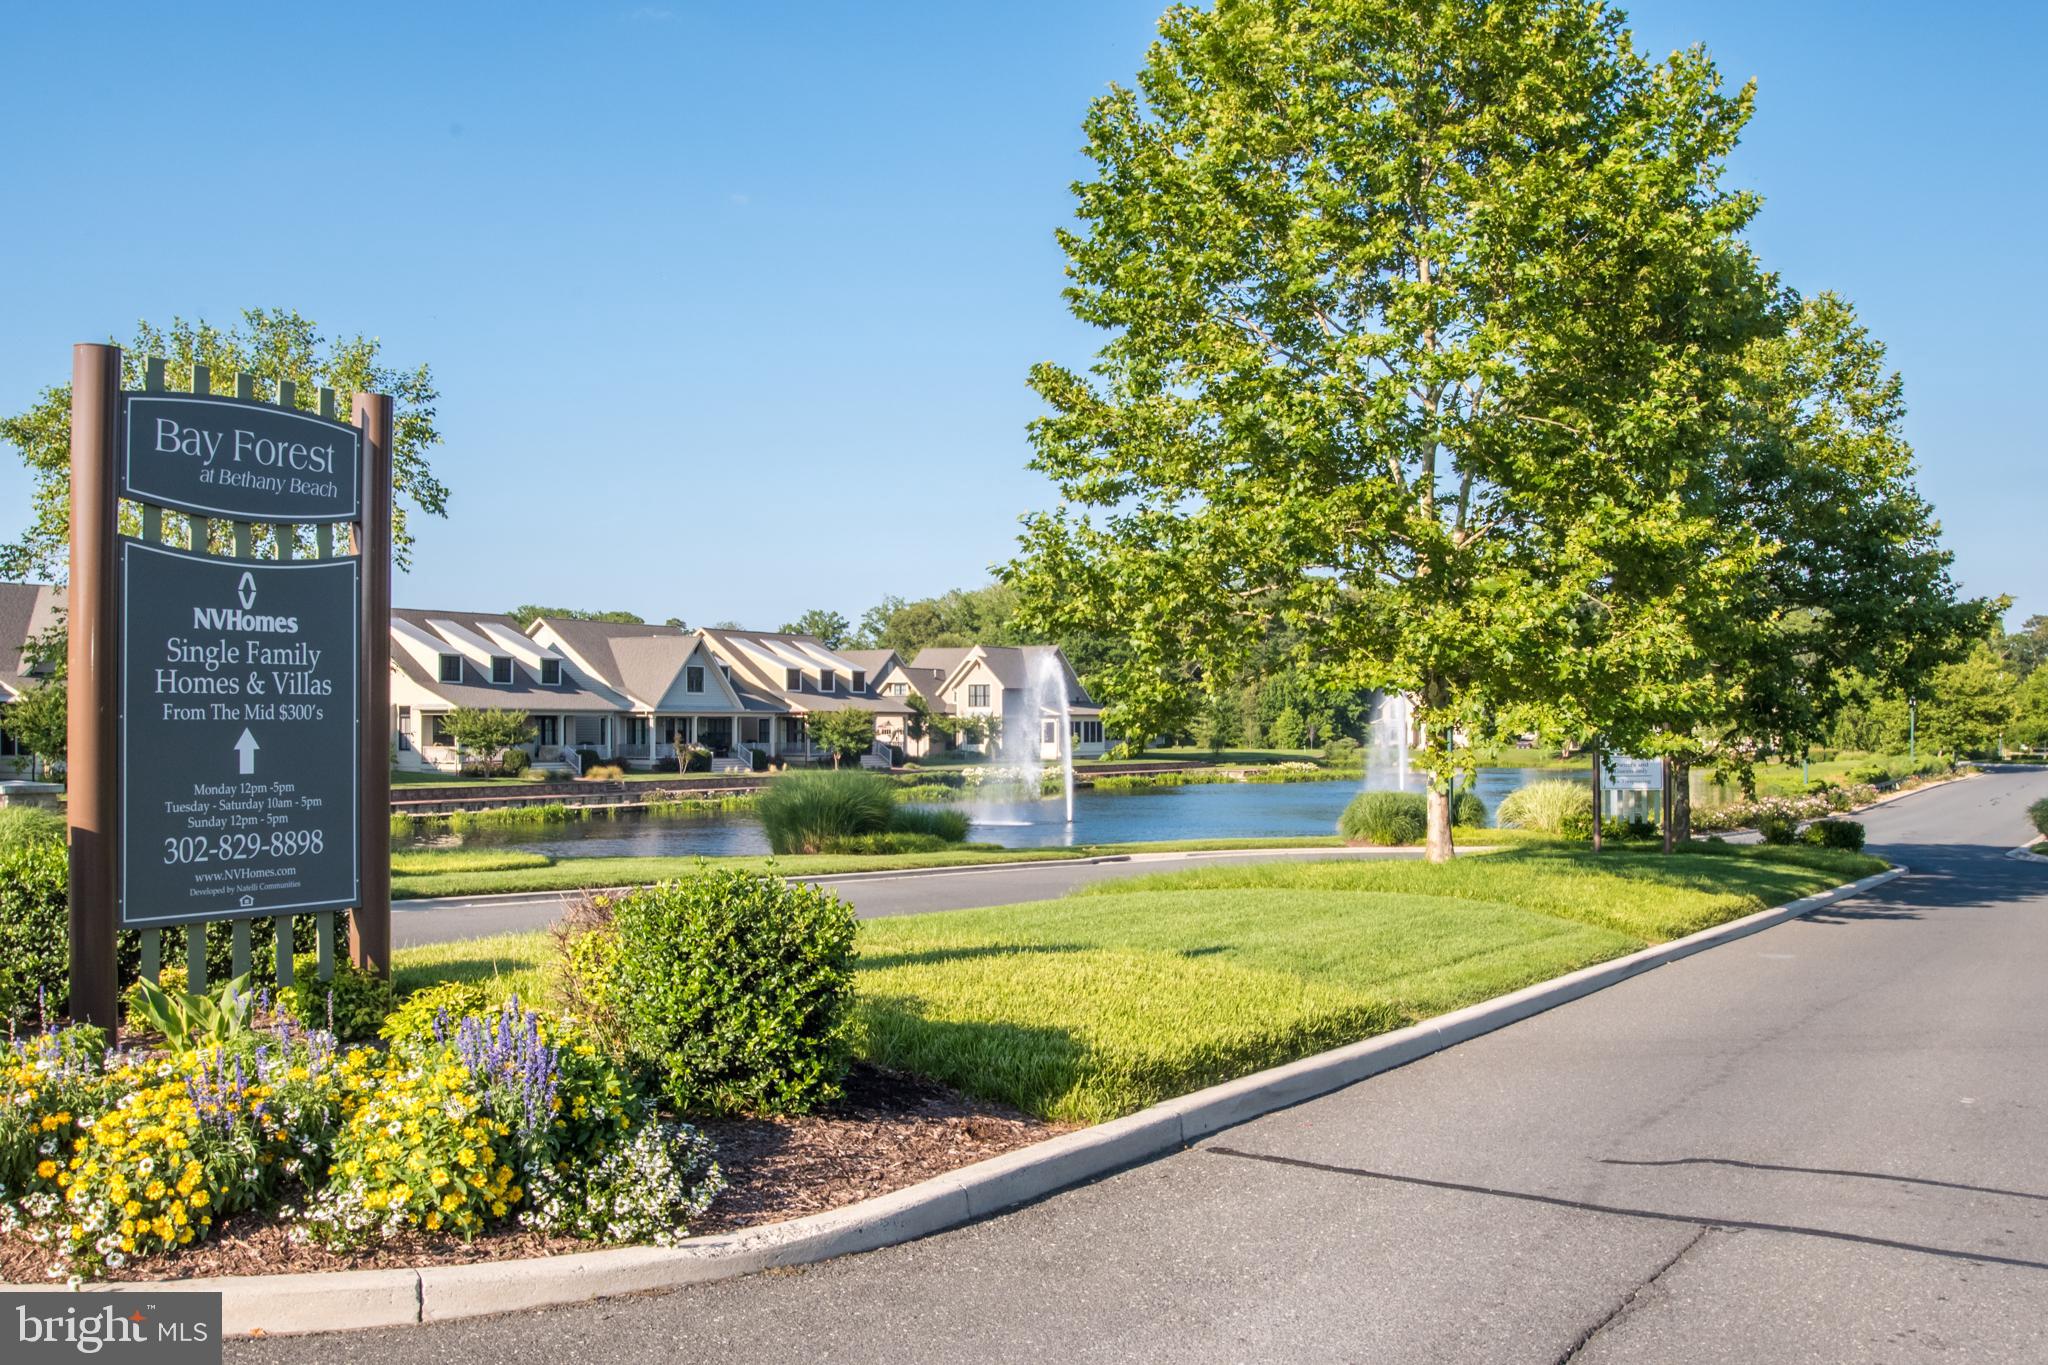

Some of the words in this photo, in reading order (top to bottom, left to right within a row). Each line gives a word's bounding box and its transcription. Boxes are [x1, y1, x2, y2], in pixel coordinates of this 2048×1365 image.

[155, 418, 223, 466] Bay
[234, 429, 335, 474] Forest
[199, 469, 214, 484] at
[219, 469, 286, 495] Bethany
[289, 478, 338, 498] Beach
[193, 607, 299, 634] NVHomes
[167, 637, 239, 671] Single
[246, 640, 322, 673] Family
[154, 668, 239, 695] Homes
[246, 671, 266, 695] &
[272, 671, 332, 696] Villas
[162, 703, 206, 721] From
[211, 703, 240, 721] The
[244, 703, 275, 721] Mid
[279, 703, 324, 722] $300's
[194, 783, 237, 797] Monday
[240, 782, 267, 796] 12pm
[165, 800, 210, 815] Tuesday
[219, 798, 264, 812] Saturday
[267, 797, 292, 809] 10am
[301, 796, 322, 809] 5pm
[187, 816, 227, 829] Sunday
[231, 815, 258, 828] 12pm
[266, 814, 289, 826] 5pm
[163, 828, 324, 865] 302-829-8898
[195, 866, 296, 882] www.NVHomes.com
[189, 886, 225, 897] Developed
[226, 885, 235, 895] by
[259, 880, 301, 892] Communities
